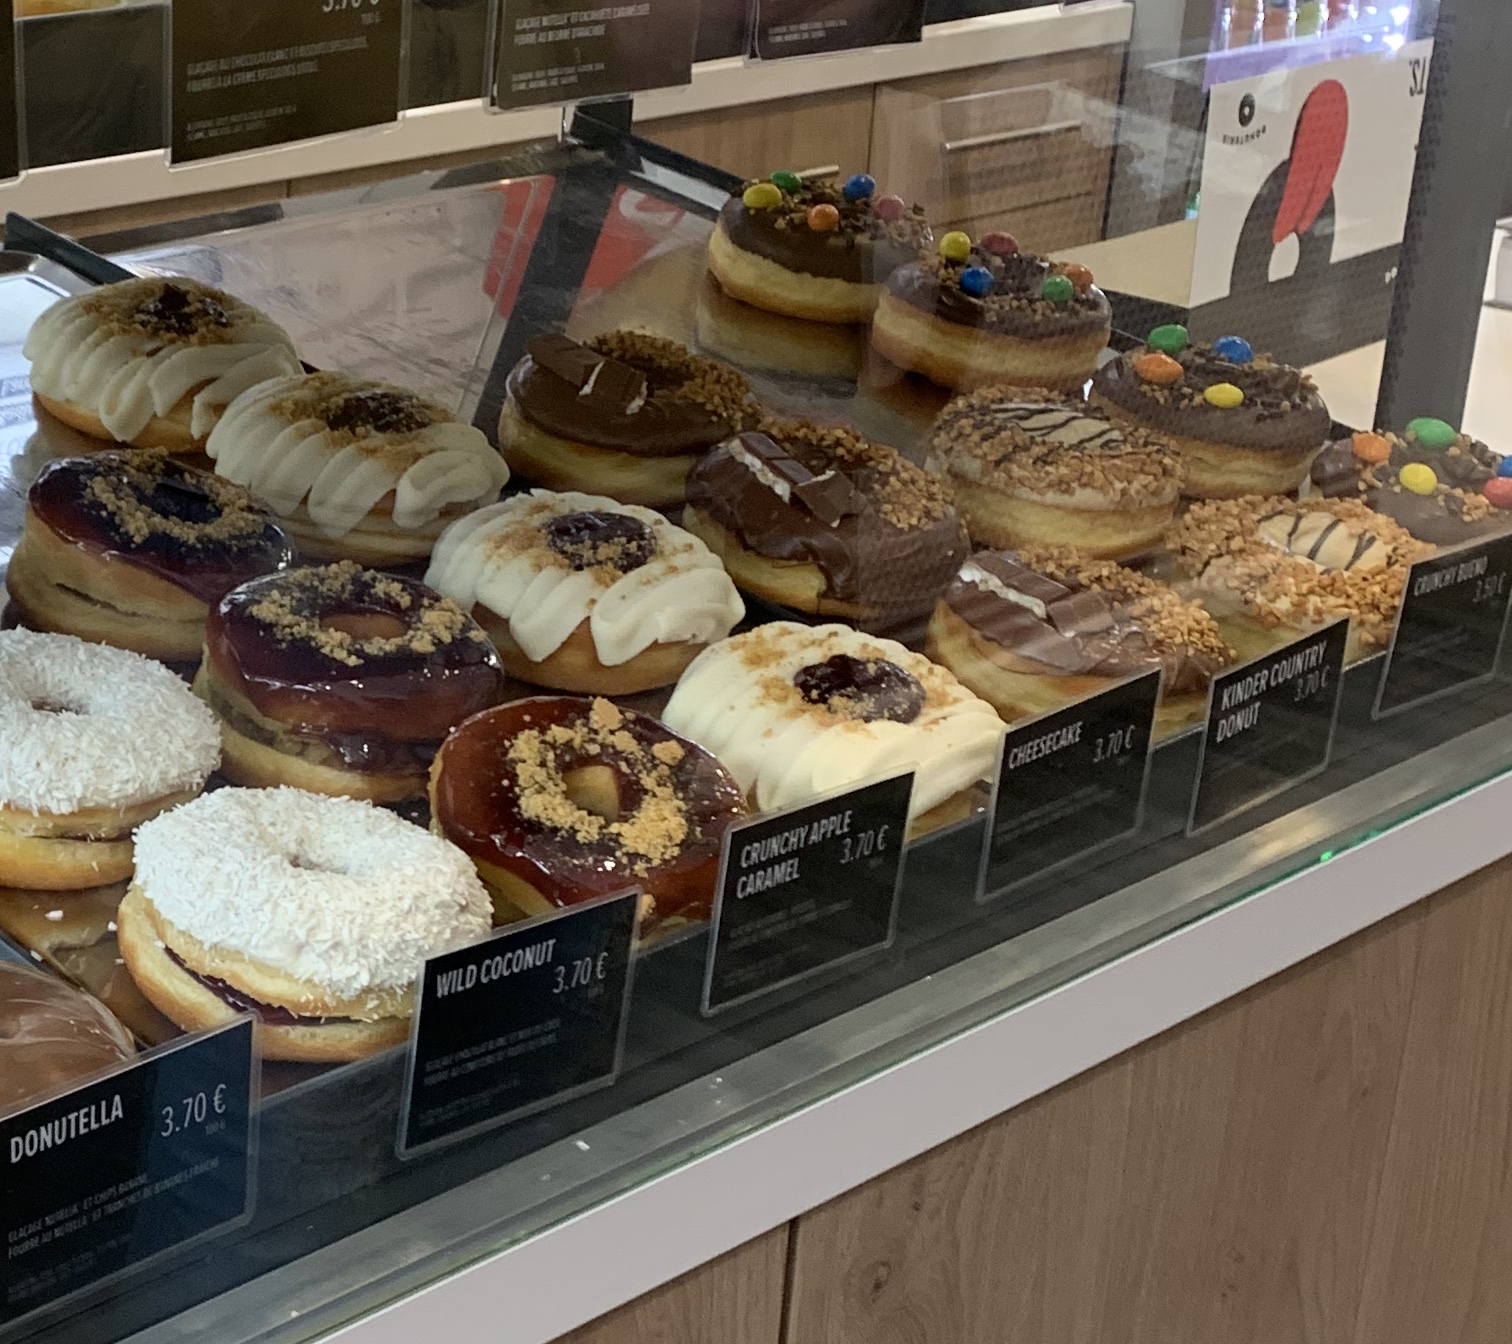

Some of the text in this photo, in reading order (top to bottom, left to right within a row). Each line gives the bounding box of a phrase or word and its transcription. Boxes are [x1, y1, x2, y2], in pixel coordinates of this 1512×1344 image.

[1220, 639, 1327, 712] KINDER COUNTRY
[1007, 718, 1083, 772] CHEESECAKE
[1215, 699, 1261, 744] DONUT
[739, 808, 853, 869] CRUNCHY APPLE
[838, 822, 890, 865] 3.70 €
[734, 855, 802, 901] CARAMEL
[434, 936, 556, 1000] WILD COCONUT
[551, 949, 609, 996] 3.70 €
[10, 1091, 123, 1165] DONUTELLA
[161, 1088, 207, 1139] 3.70
[213, 1080, 226, 1117] €
